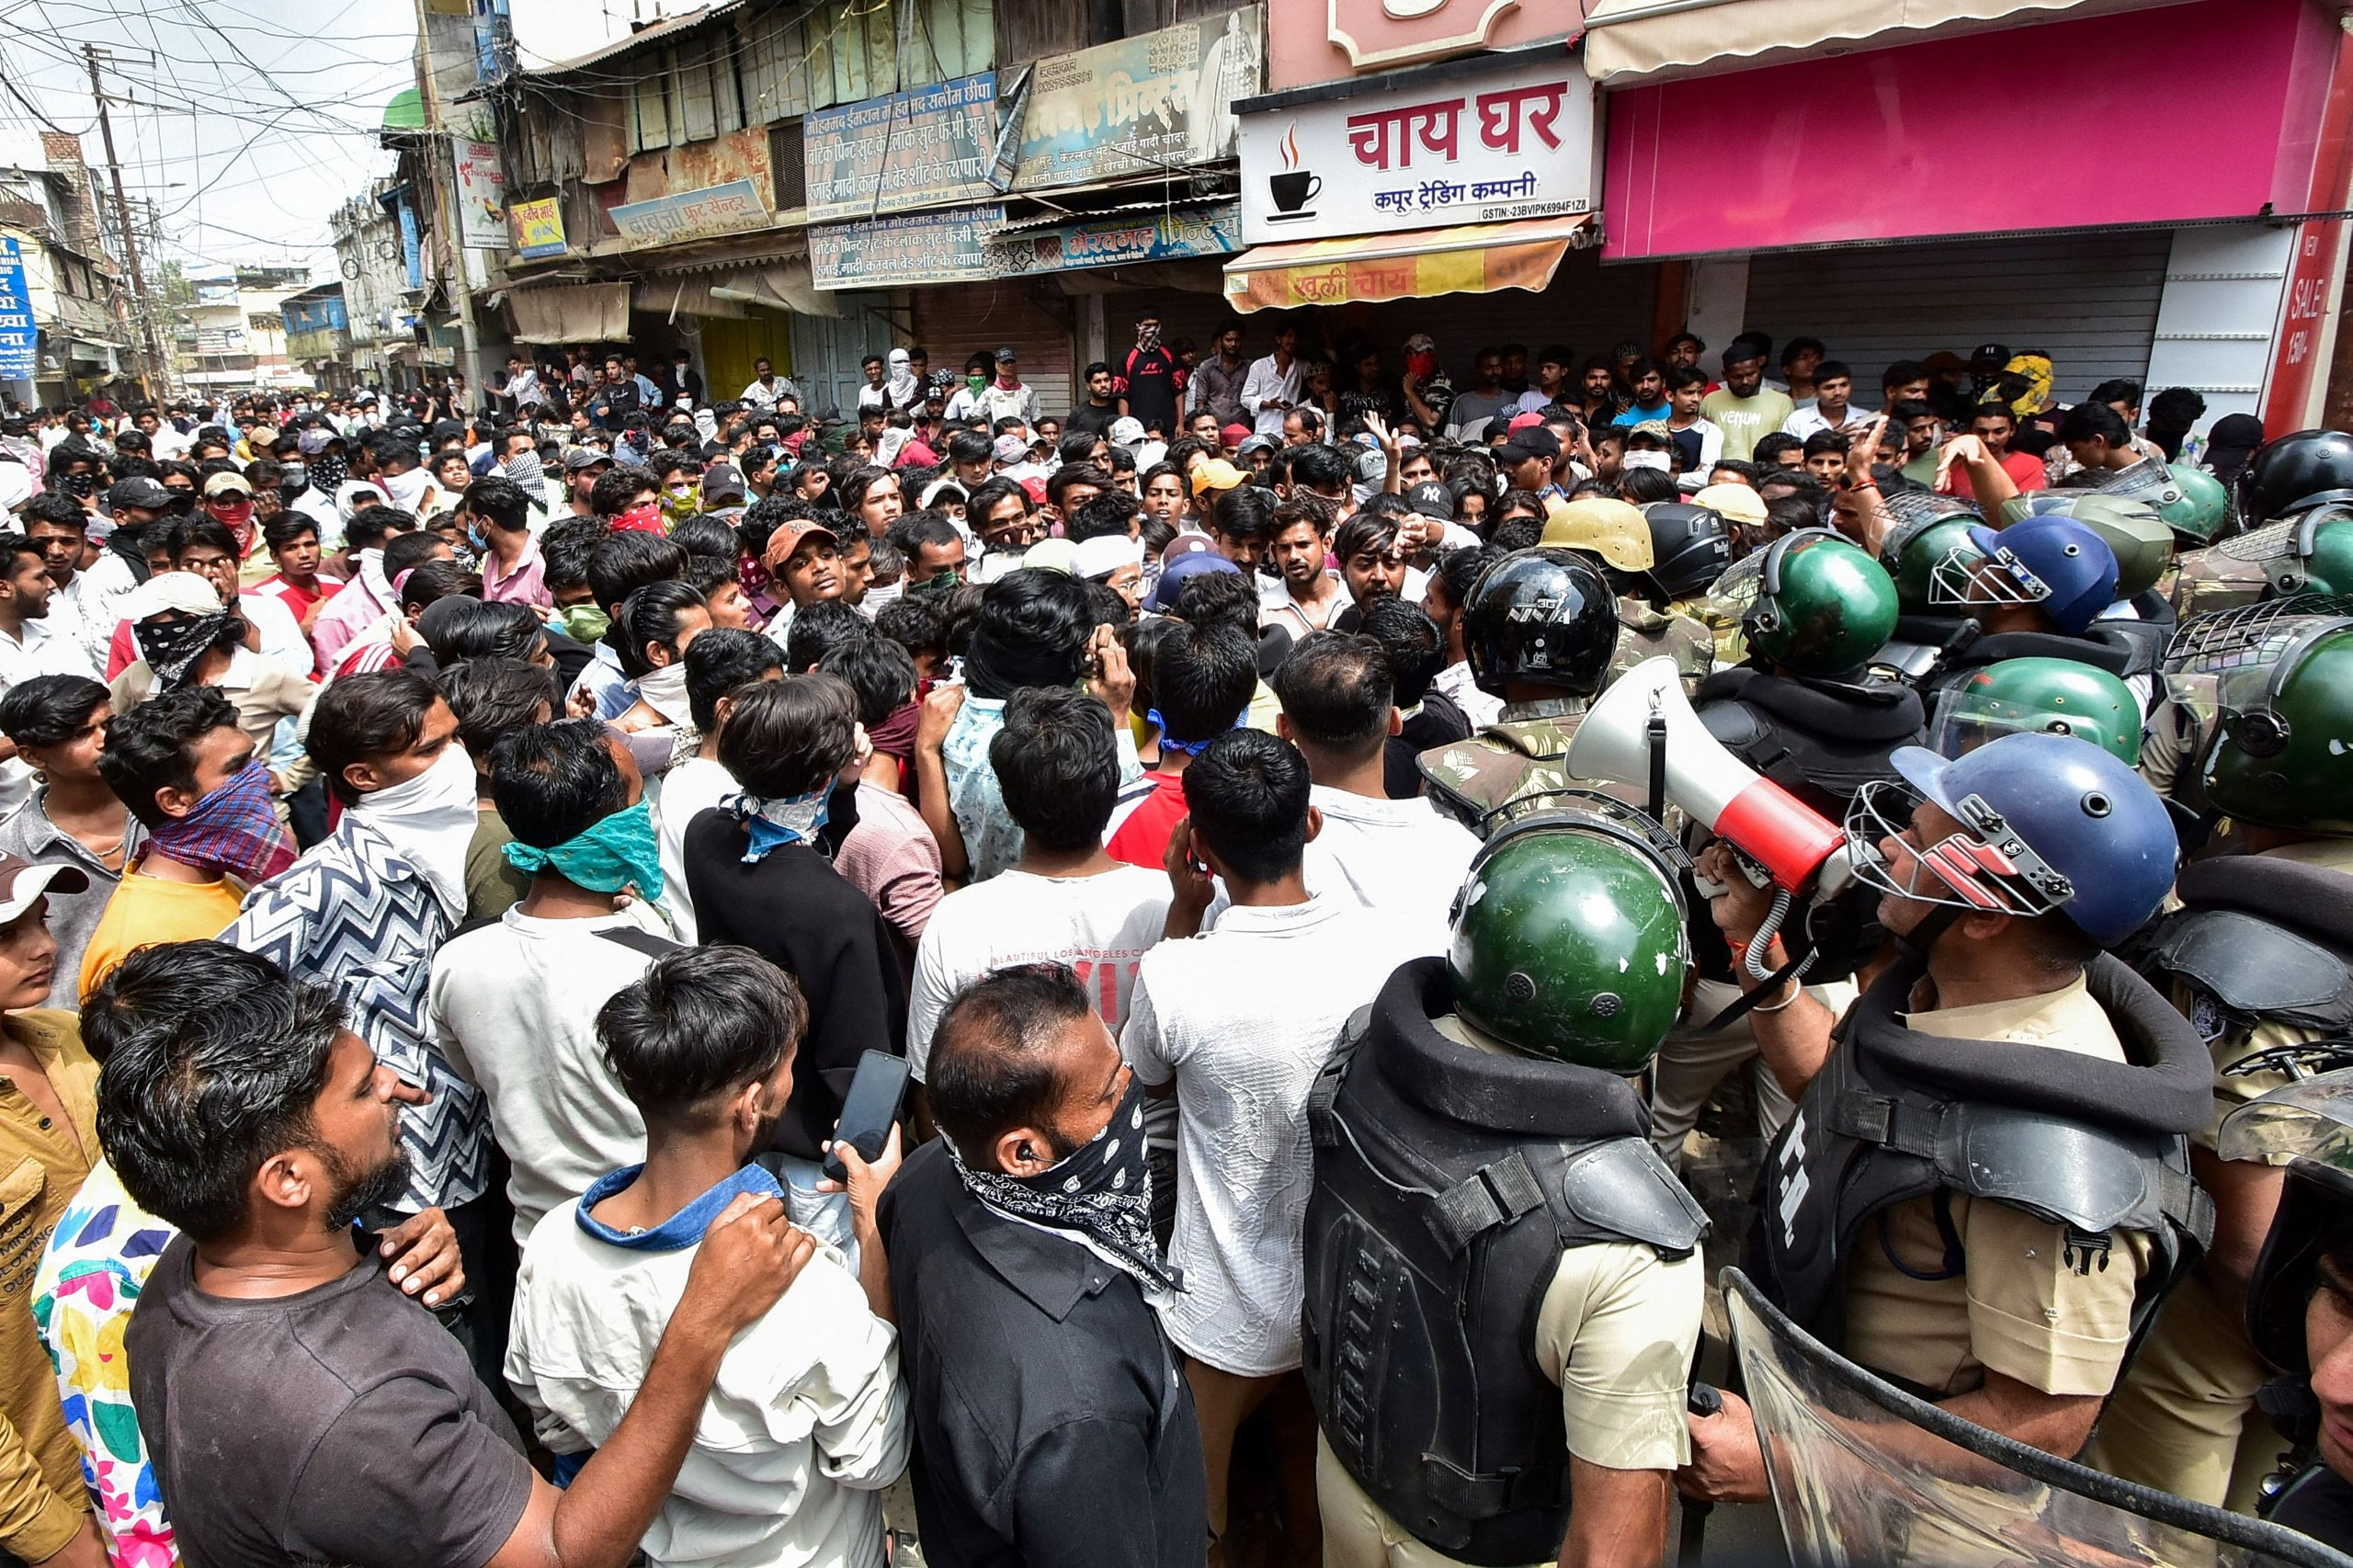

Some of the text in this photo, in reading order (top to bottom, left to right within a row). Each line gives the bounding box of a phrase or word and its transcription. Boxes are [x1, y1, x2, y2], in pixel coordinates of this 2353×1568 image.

[1347, 81, 1569, 171] चाय घर
[1375, 170, 1537, 213] कपूर ट्रेडिंग कम्पनी
[2291, 278, 2324, 320] SALE
[1720, 410, 1762, 428] VENUM
[1054, 949, 1074, 959] LOS
[1076, 949, 1129, 959] ANGELES
